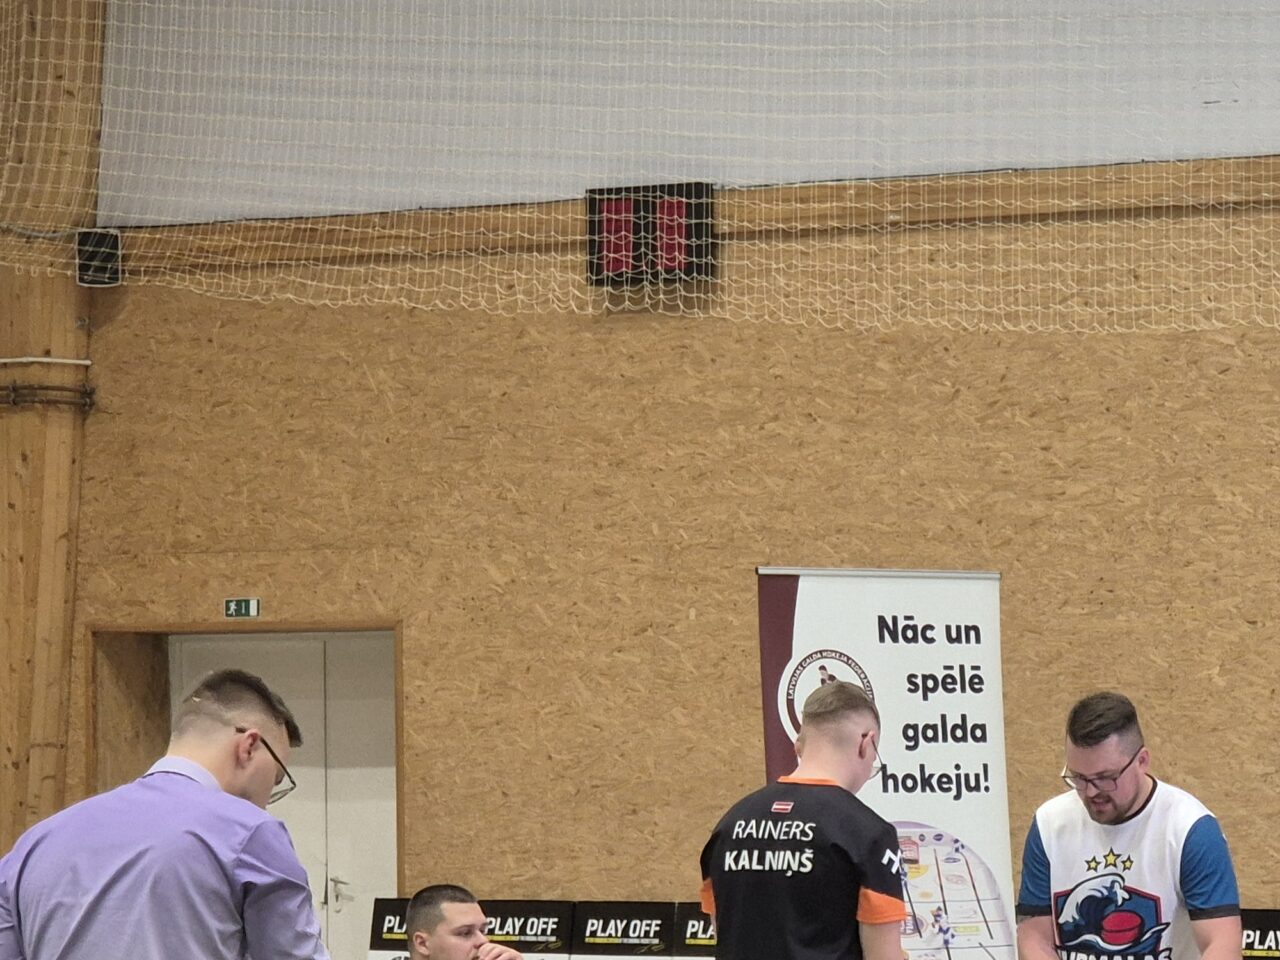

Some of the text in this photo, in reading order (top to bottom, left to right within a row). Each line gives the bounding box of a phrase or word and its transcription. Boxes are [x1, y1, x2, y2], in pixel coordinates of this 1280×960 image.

[877, 615, 982, 645] Nāc un
[906, 664, 985, 701] spēlē
[902, 713, 987, 751] galda
[881, 763, 990, 801] hokeju!
[732, 819, 816, 842] RAINERS
[724, 847, 814, 877] KALNIŅŠ
[383, 915, 408, 934] PL
[484, 916, 559, 936] PLAY OFF
[585, 918, 662, 938] PLAY OFF
[685, 920, 716, 939] PLA
